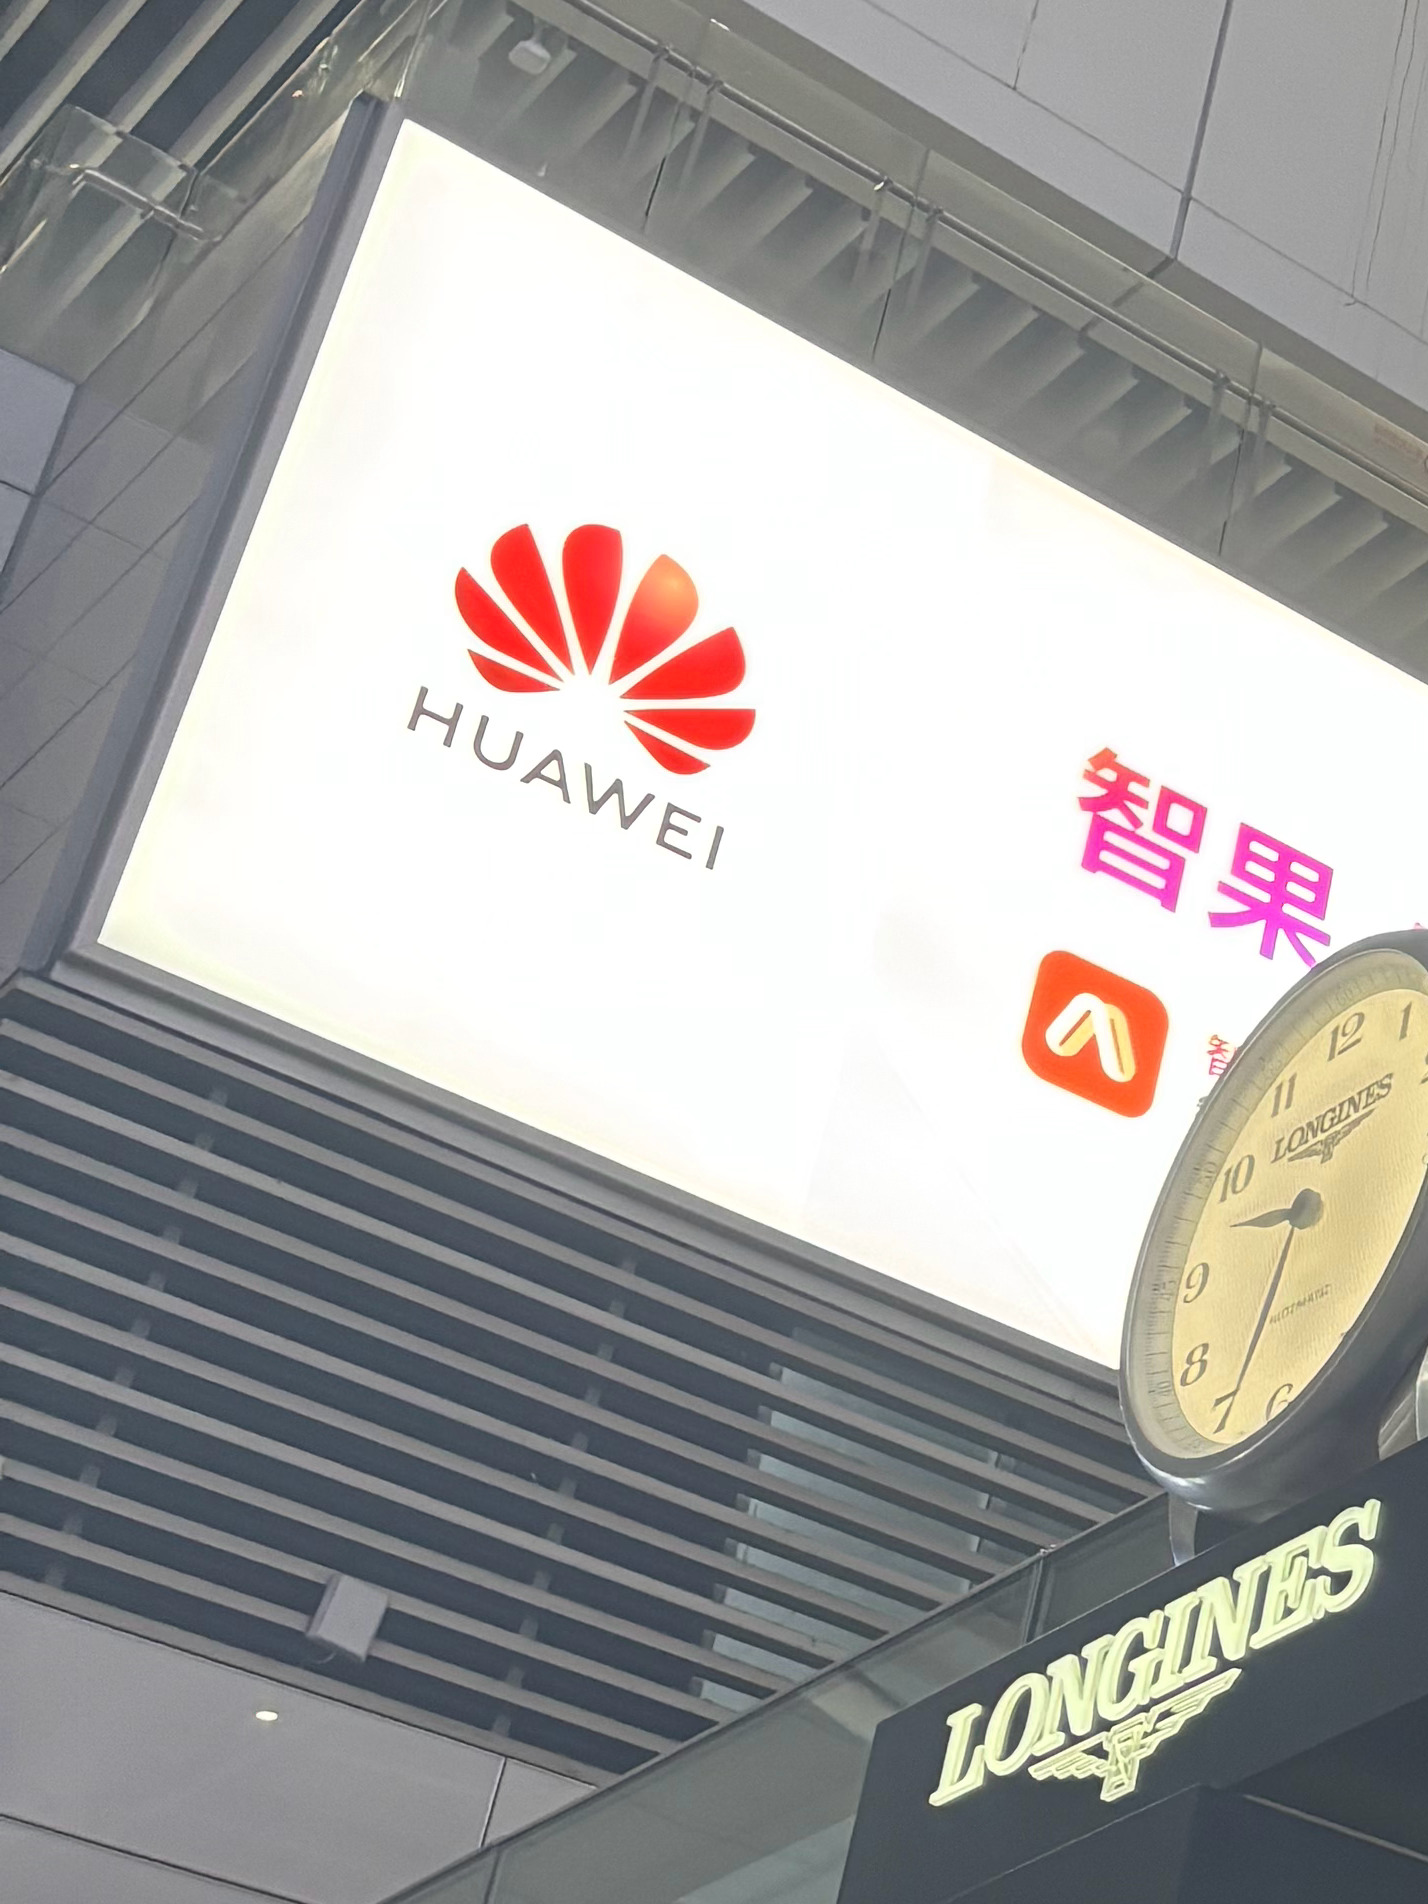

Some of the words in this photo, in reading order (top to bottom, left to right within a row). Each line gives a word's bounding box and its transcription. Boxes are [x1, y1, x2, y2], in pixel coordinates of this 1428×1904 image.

[407, 686, 724, 869] HUAWEI
[1327, 1011, 1365, 1062] 12
[1399, 1001, 1413, 1041] 1
[1271, 1072, 1297, 1118] 11
[1271, 1073, 1393, 1164] LONGINES
[1218, 1154, 1255, 1205] 10
[1183, 1262, 1209, 1304] 9
[1180, 1343, 1209, 1387] 8
[1212, 1386, 1240, 1434] 7
[928, 1498, 1381, 1807] LONGINES
